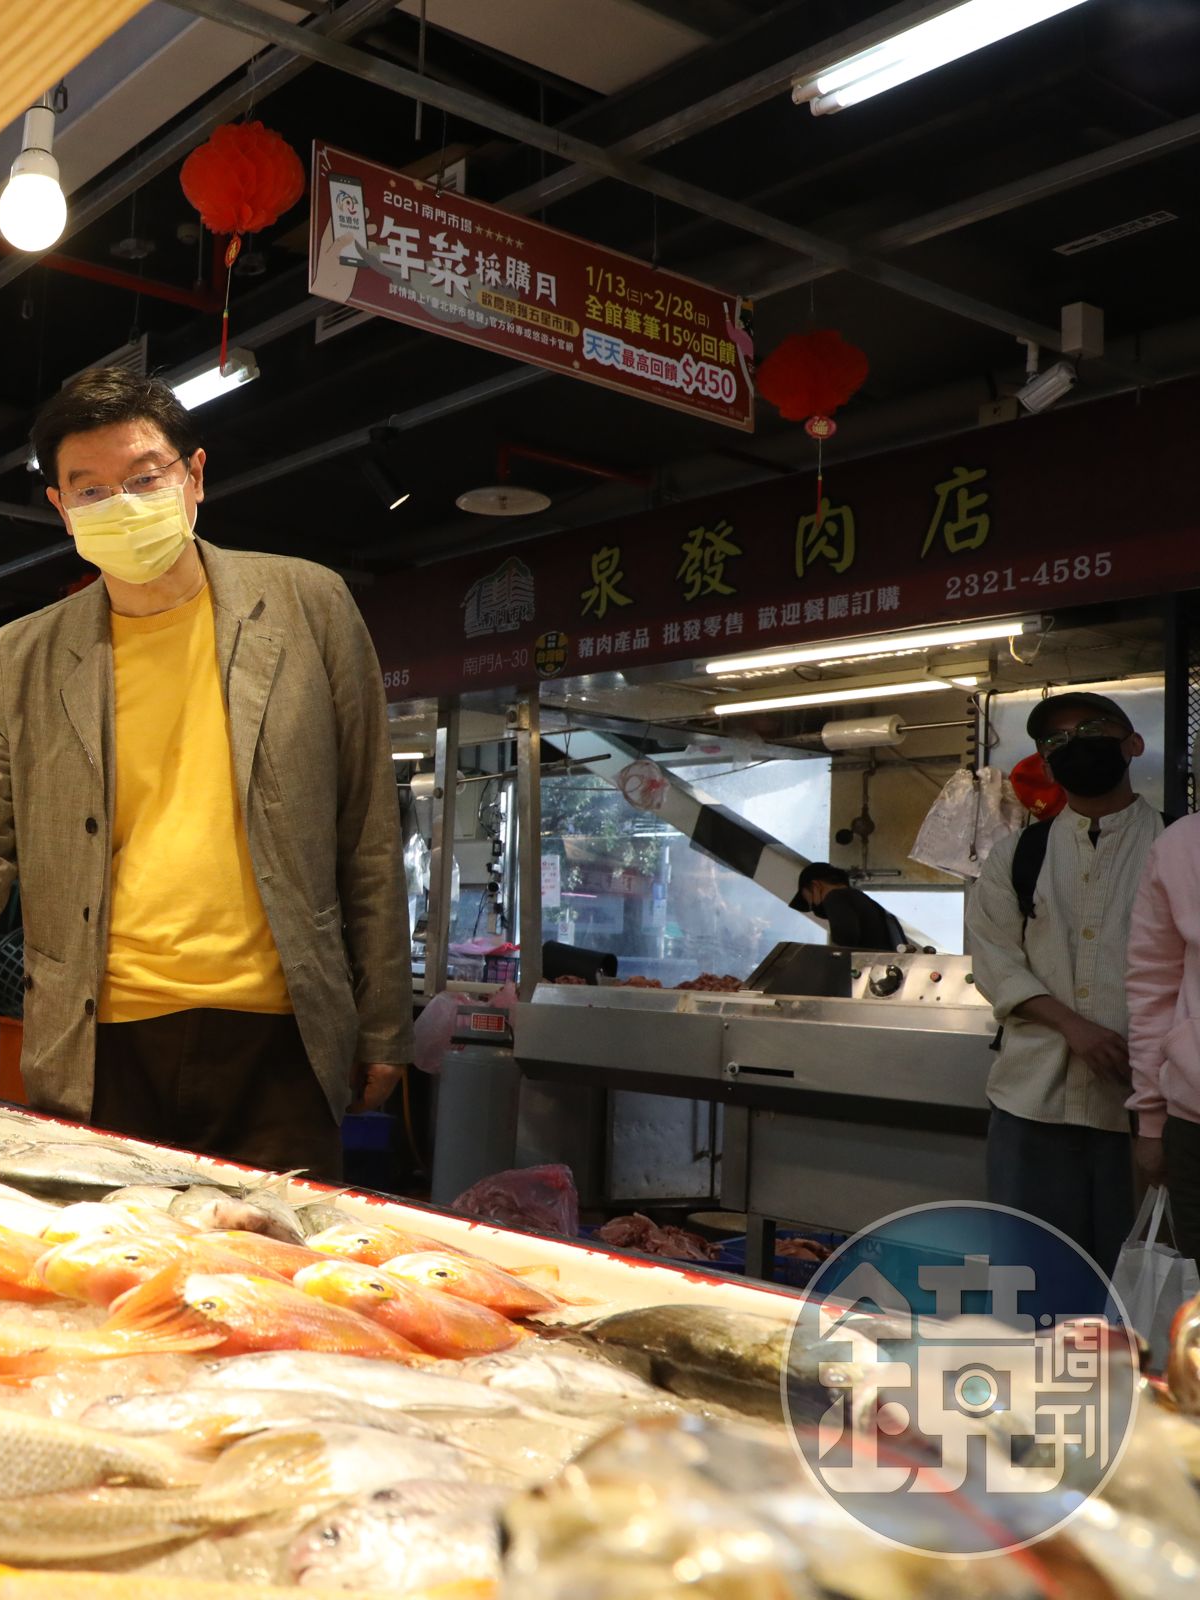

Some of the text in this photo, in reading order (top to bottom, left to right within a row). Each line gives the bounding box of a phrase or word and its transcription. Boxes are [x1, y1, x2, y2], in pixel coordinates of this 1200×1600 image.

[383, 190, 473, 234] 2021南門市場
[379, 215, 558, 308] 年菜採購月
[585, 294, 737, 367] 全館筆筆15%回饋
[579, 465, 991, 620] 泉發肉店
[576, 551, 1113, 659] 豬肉產品 批發零售 歡迎餐廳訂購 2321-4585
[462, 648, 528, 676] 南門A-30
